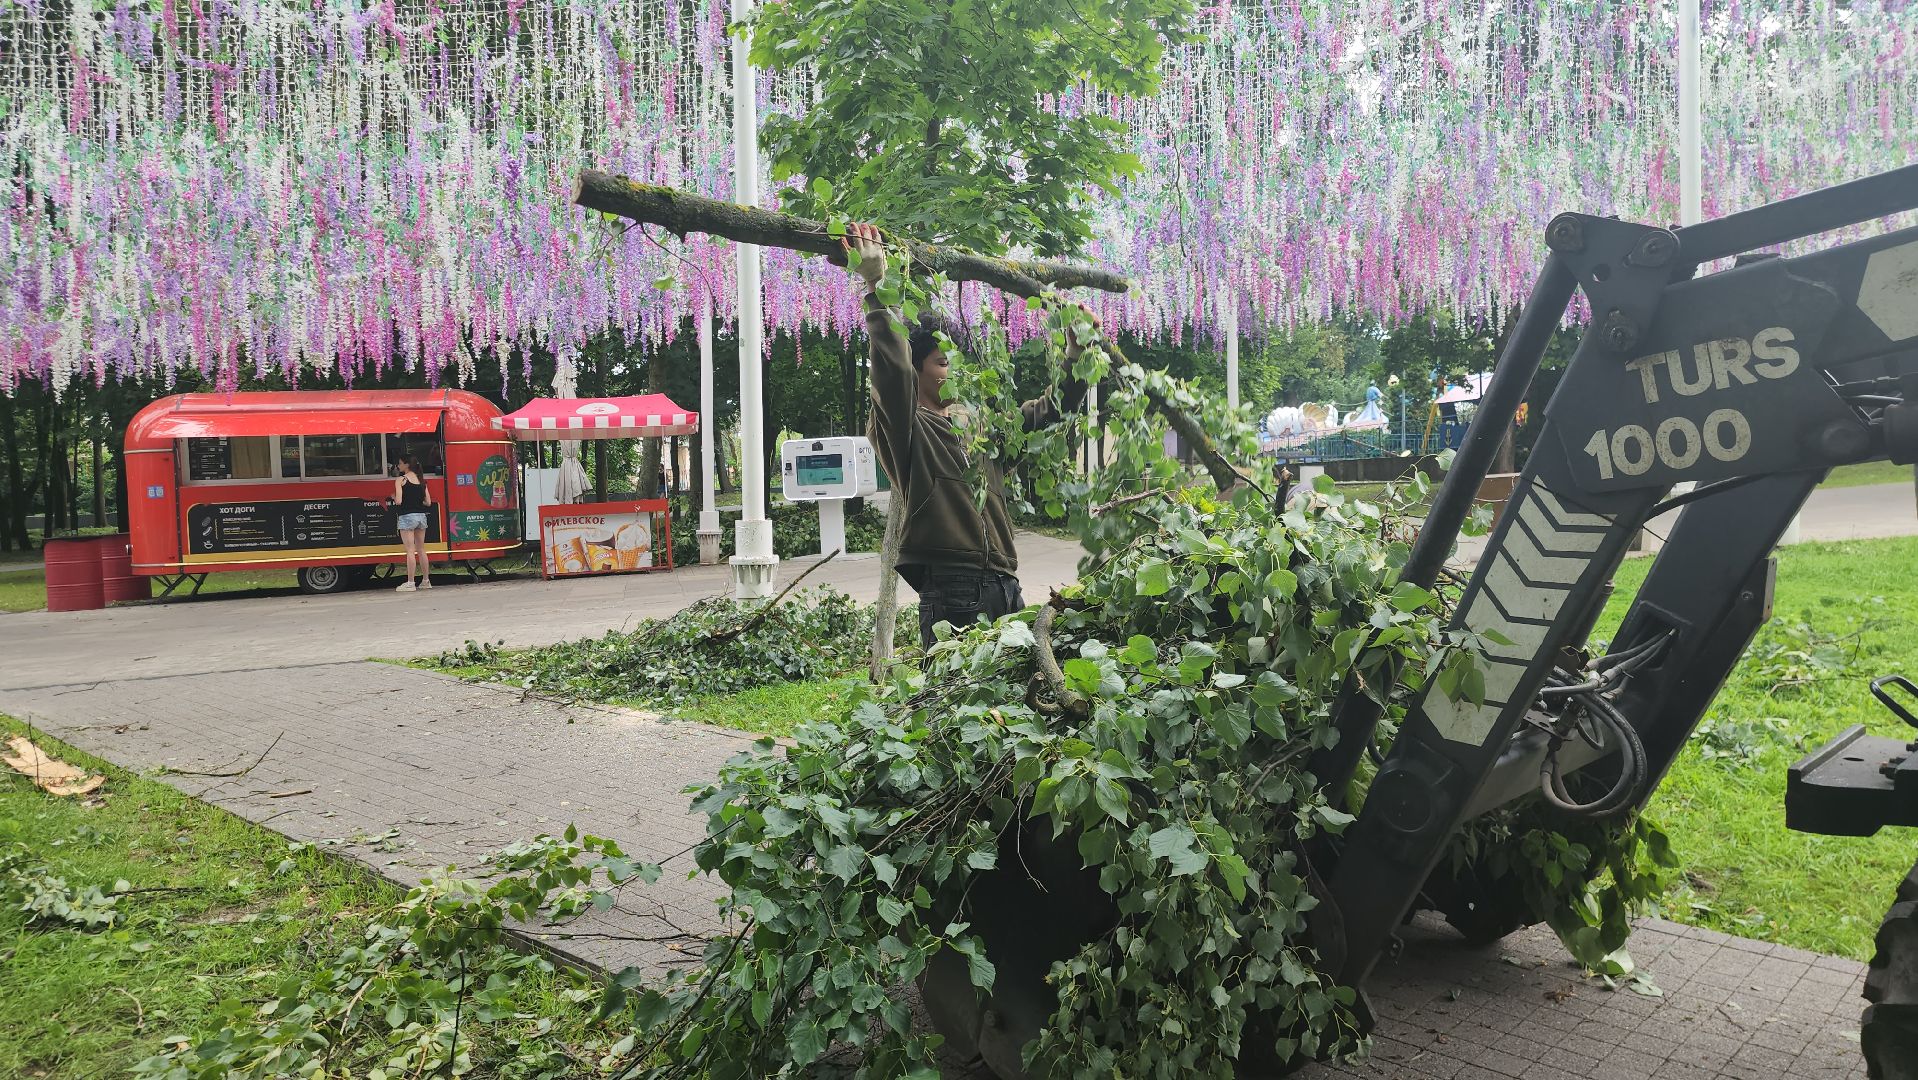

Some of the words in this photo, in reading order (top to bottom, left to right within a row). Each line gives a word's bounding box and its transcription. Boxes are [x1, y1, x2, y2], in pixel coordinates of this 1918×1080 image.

[1625, 327, 1800, 403] TURS
[1584, 408, 1751, 479] 1000
[234, 506, 256, 514] ДОГИ
[303, 503, 330, 511] ДЕСЕРТ
[544, 516, 606, 529] ФИЛЕВСКОЕ
